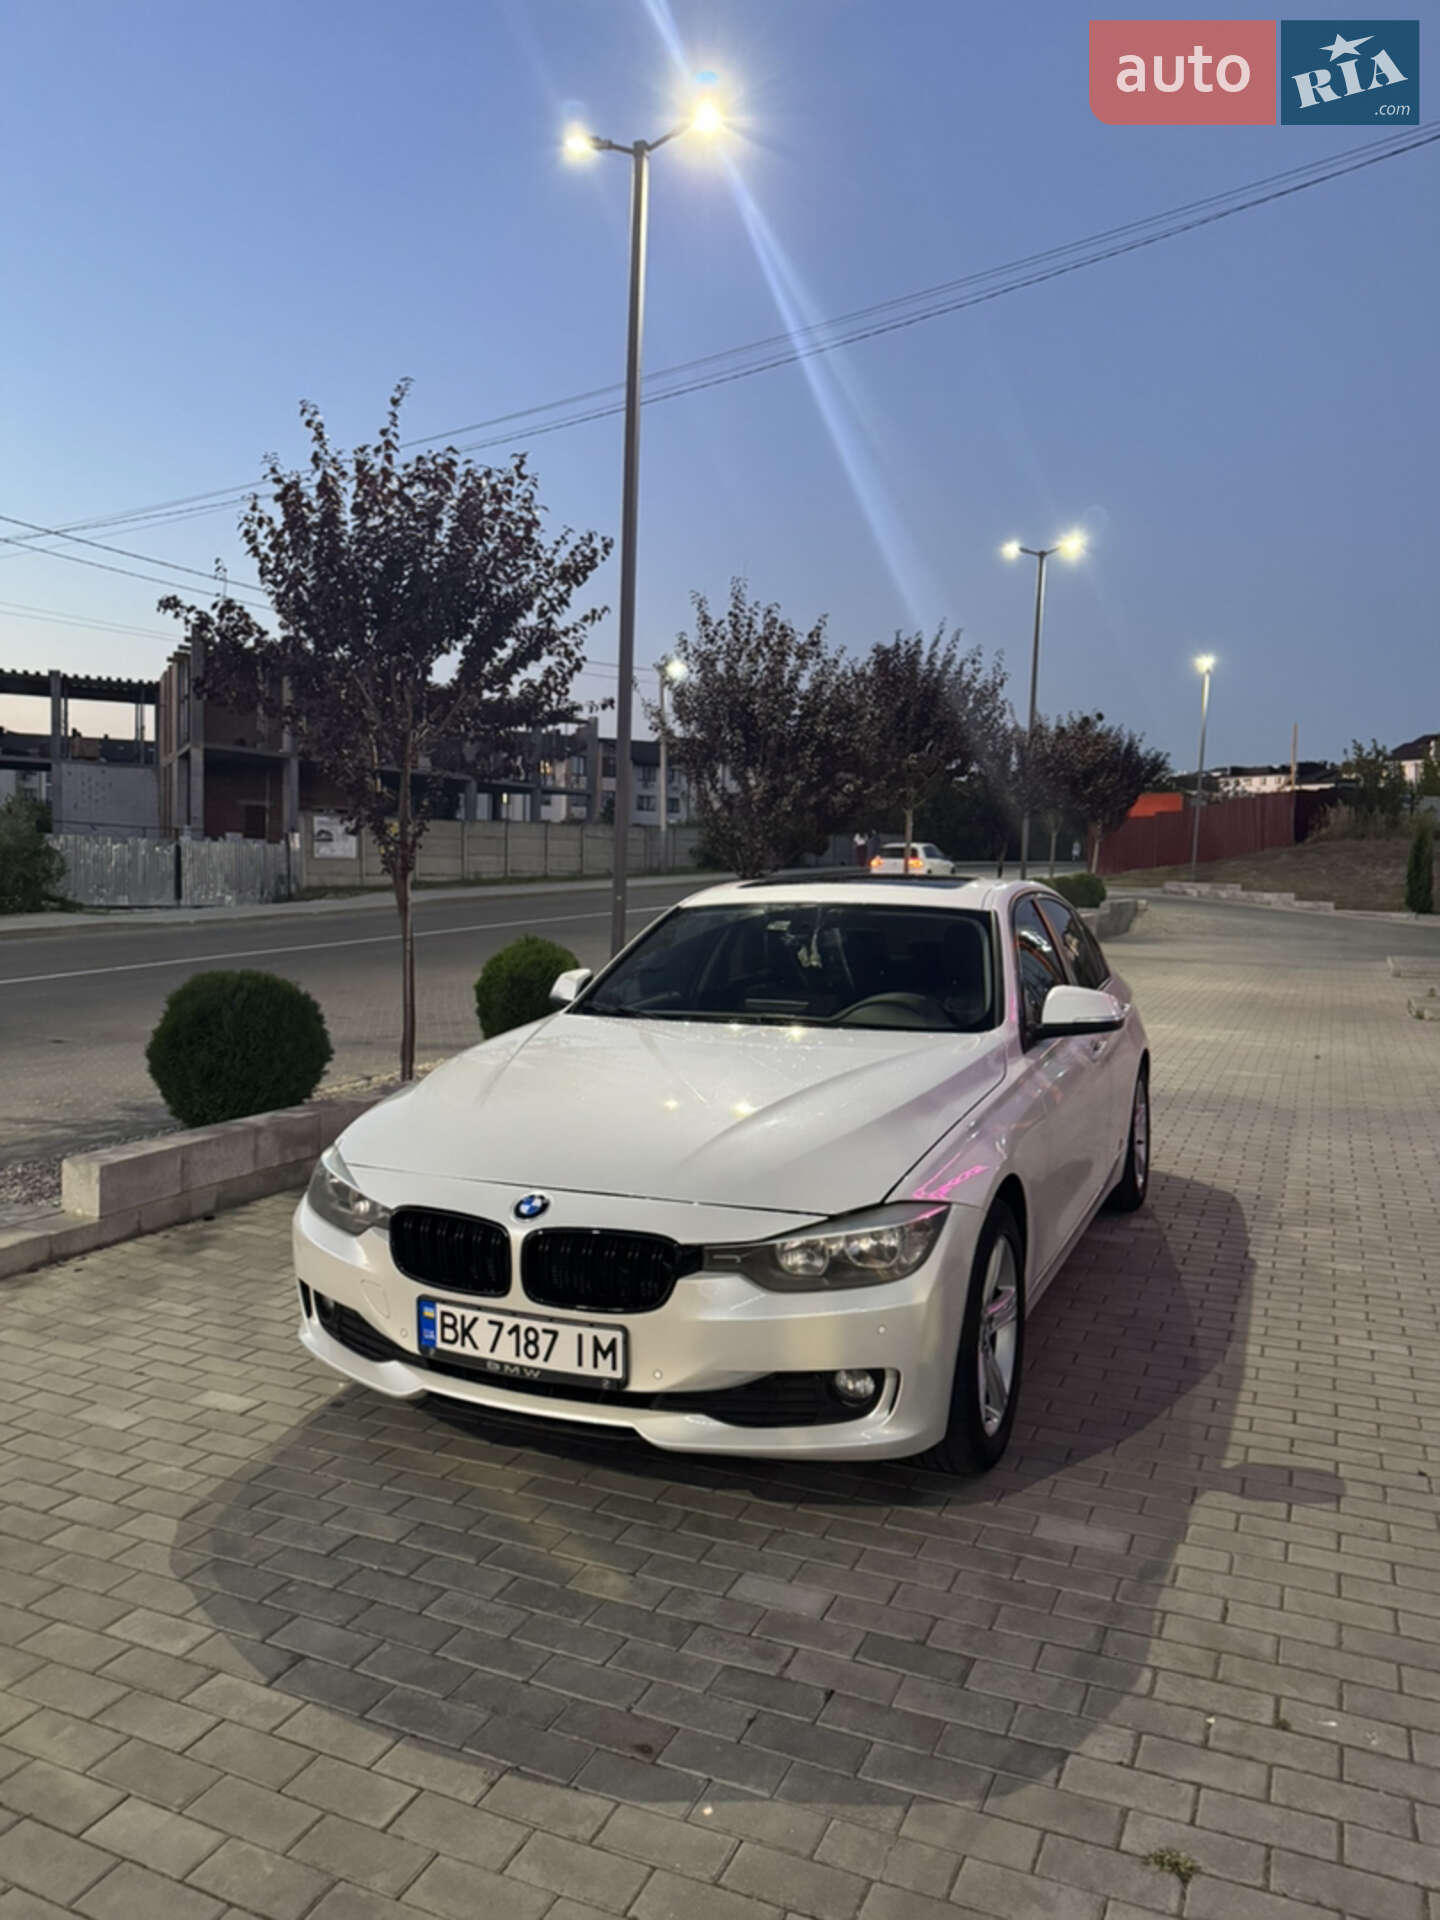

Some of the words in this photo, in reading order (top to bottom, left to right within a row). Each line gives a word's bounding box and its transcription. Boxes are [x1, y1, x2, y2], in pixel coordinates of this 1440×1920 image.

[440, 1311, 479, 1350] BK
[487, 1319, 559, 1362] 7187
[577, 1333, 617, 1371] IM
[486, 1361, 541, 1379] BMW
